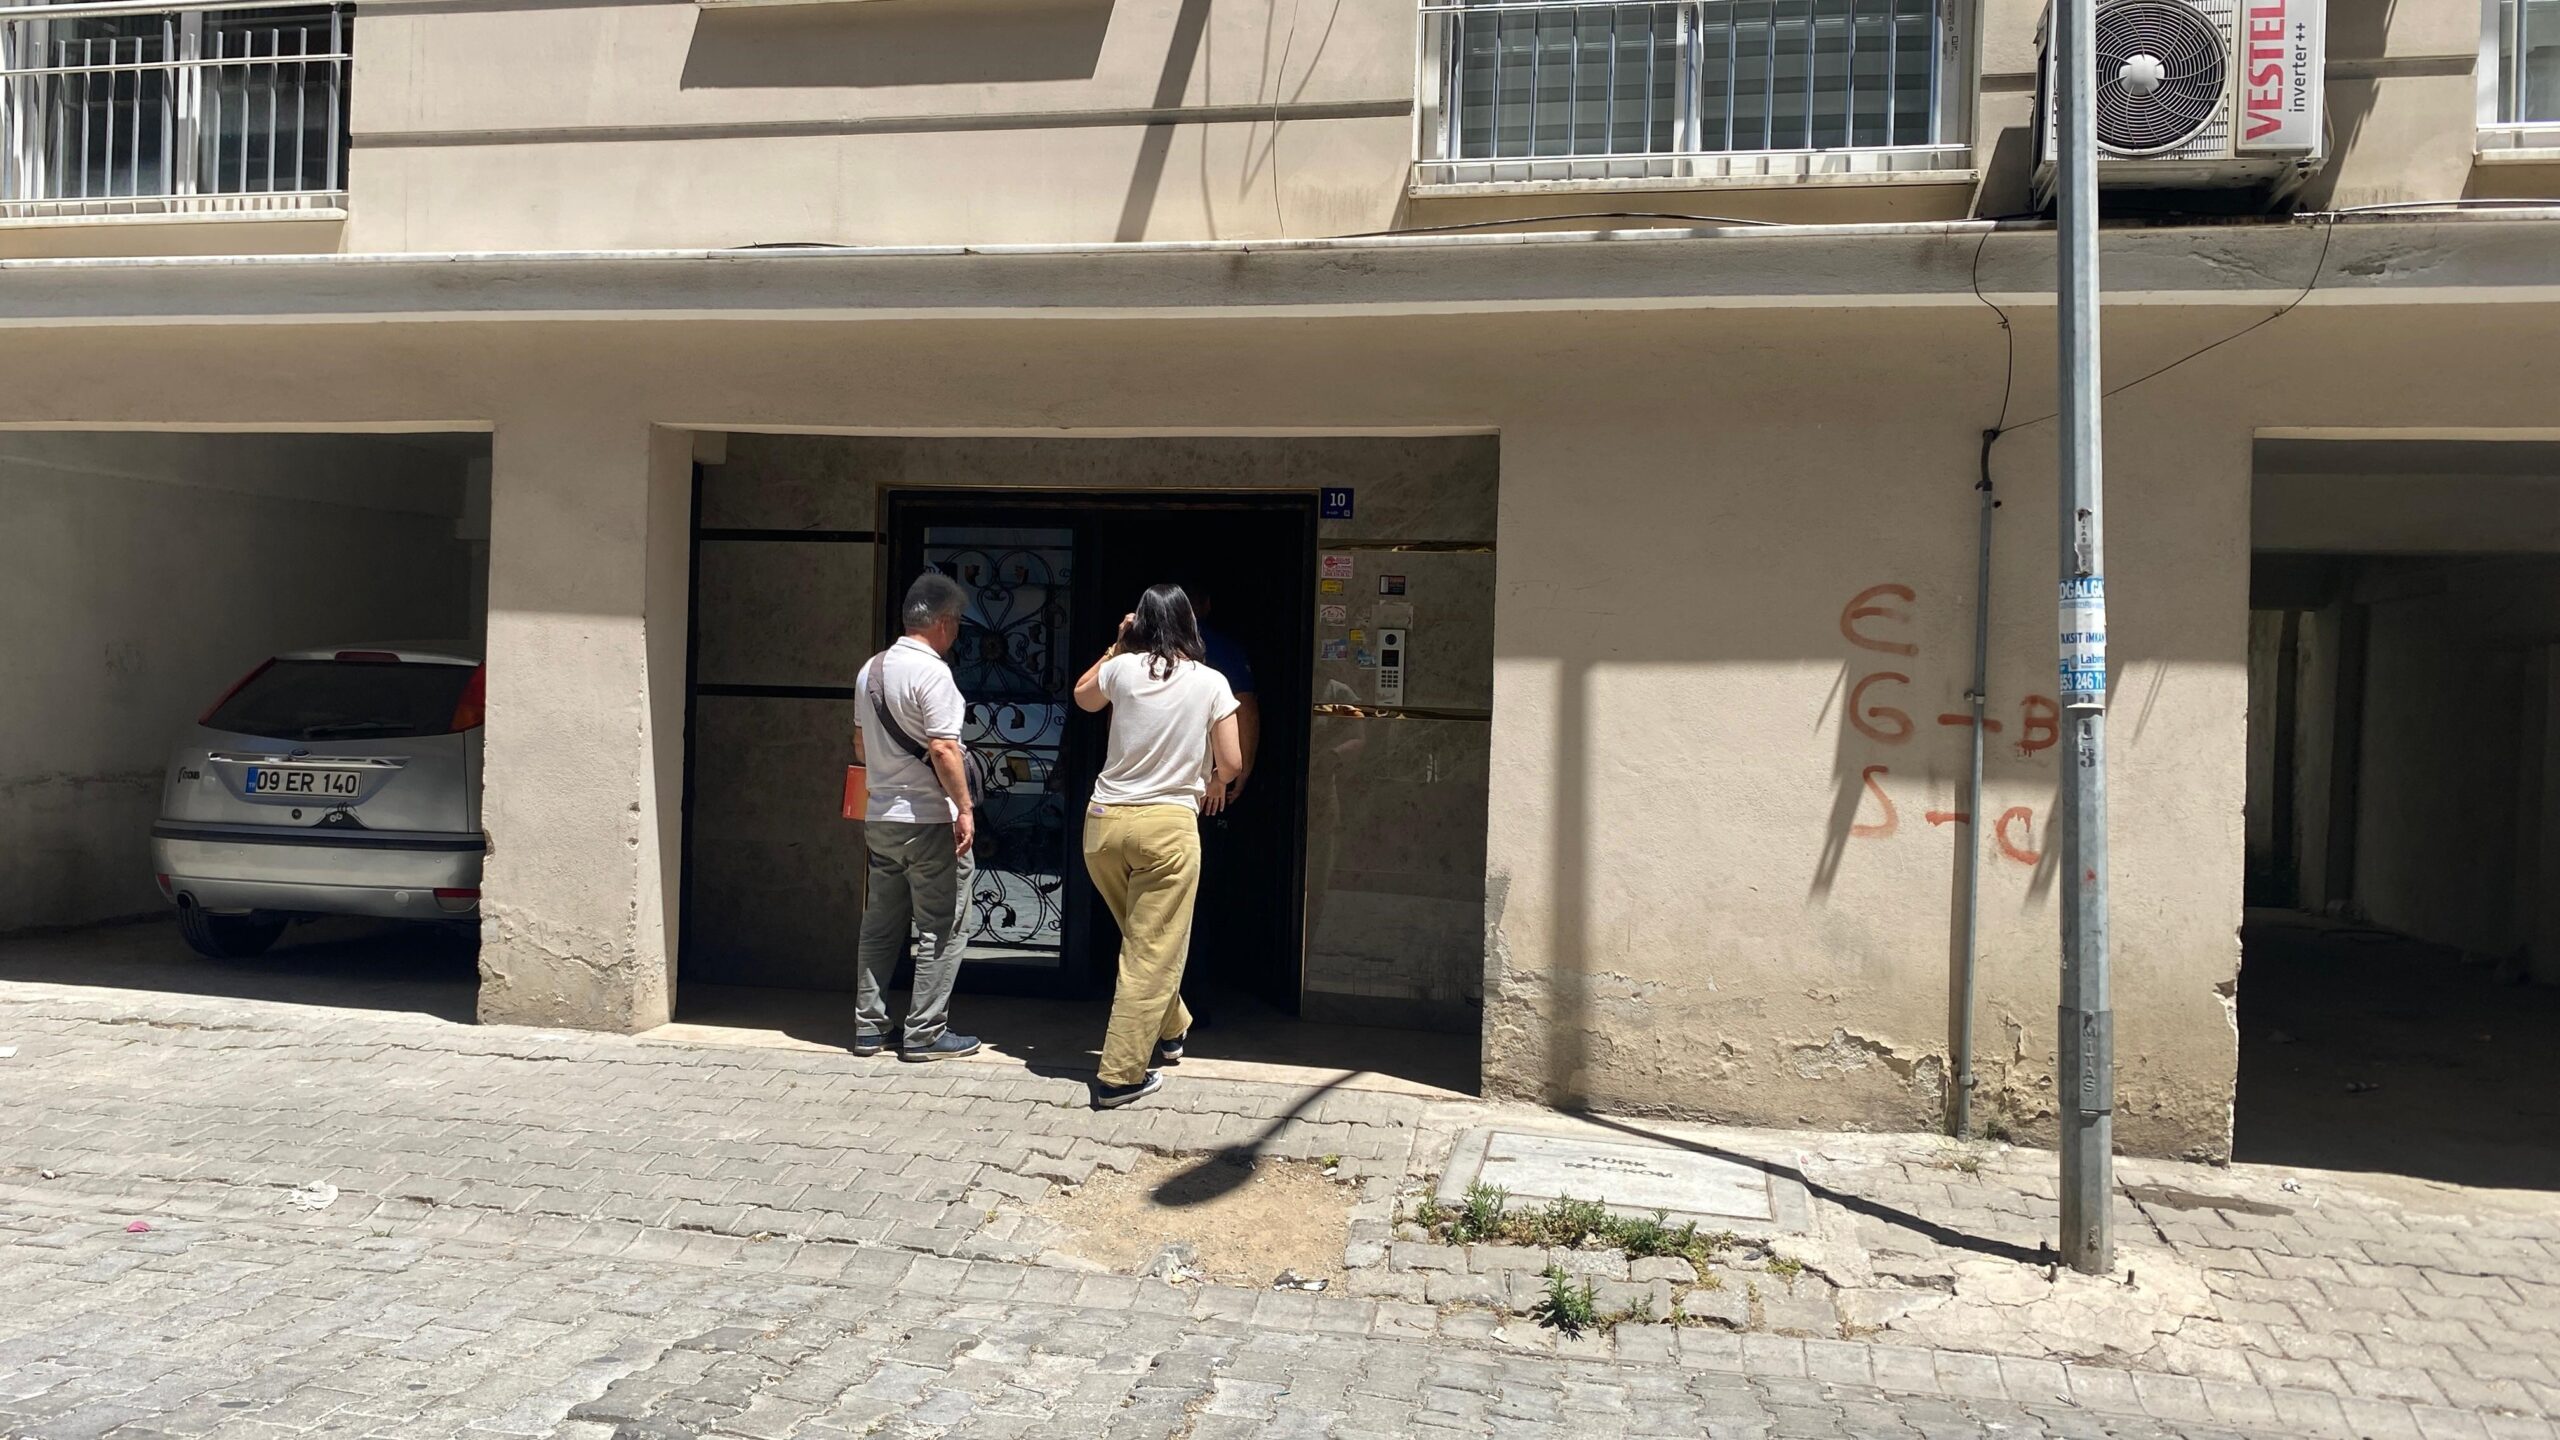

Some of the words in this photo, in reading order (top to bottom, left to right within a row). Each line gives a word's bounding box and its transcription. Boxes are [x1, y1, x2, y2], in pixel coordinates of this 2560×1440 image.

[2246, 0, 2286, 141] VESTEL
[2289, 22, 2308, 112] inverter++
[1329, 492, 1346, 507] 10
[2075, 671, 2094, 690] 246
[2095, 671, 2106, 689] 71
[257, 770, 280, 791] 09
[285, 772, 315, 792] ER
[323, 773, 357, 794] 140
